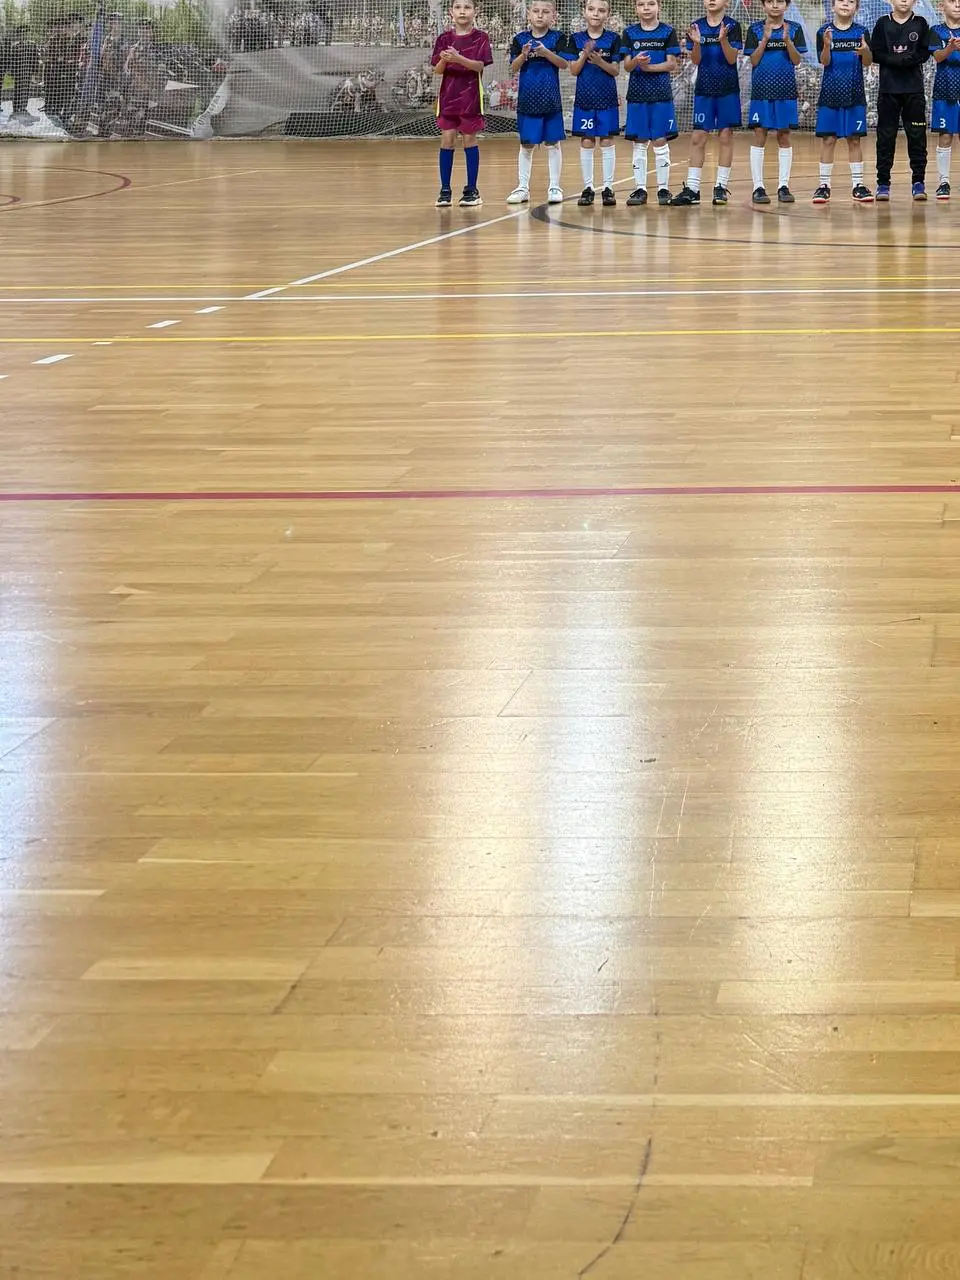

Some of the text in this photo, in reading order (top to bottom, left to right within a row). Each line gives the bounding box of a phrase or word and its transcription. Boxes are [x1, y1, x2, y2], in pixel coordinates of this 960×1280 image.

[694, 112, 706, 123] 10
[752, 112, 759, 123] 4
[939, 118, 946, 128] 3
[581, 118, 594, 130] 26
[668, 119, 674, 130] 7
[856, 120, 863, 130] 7
